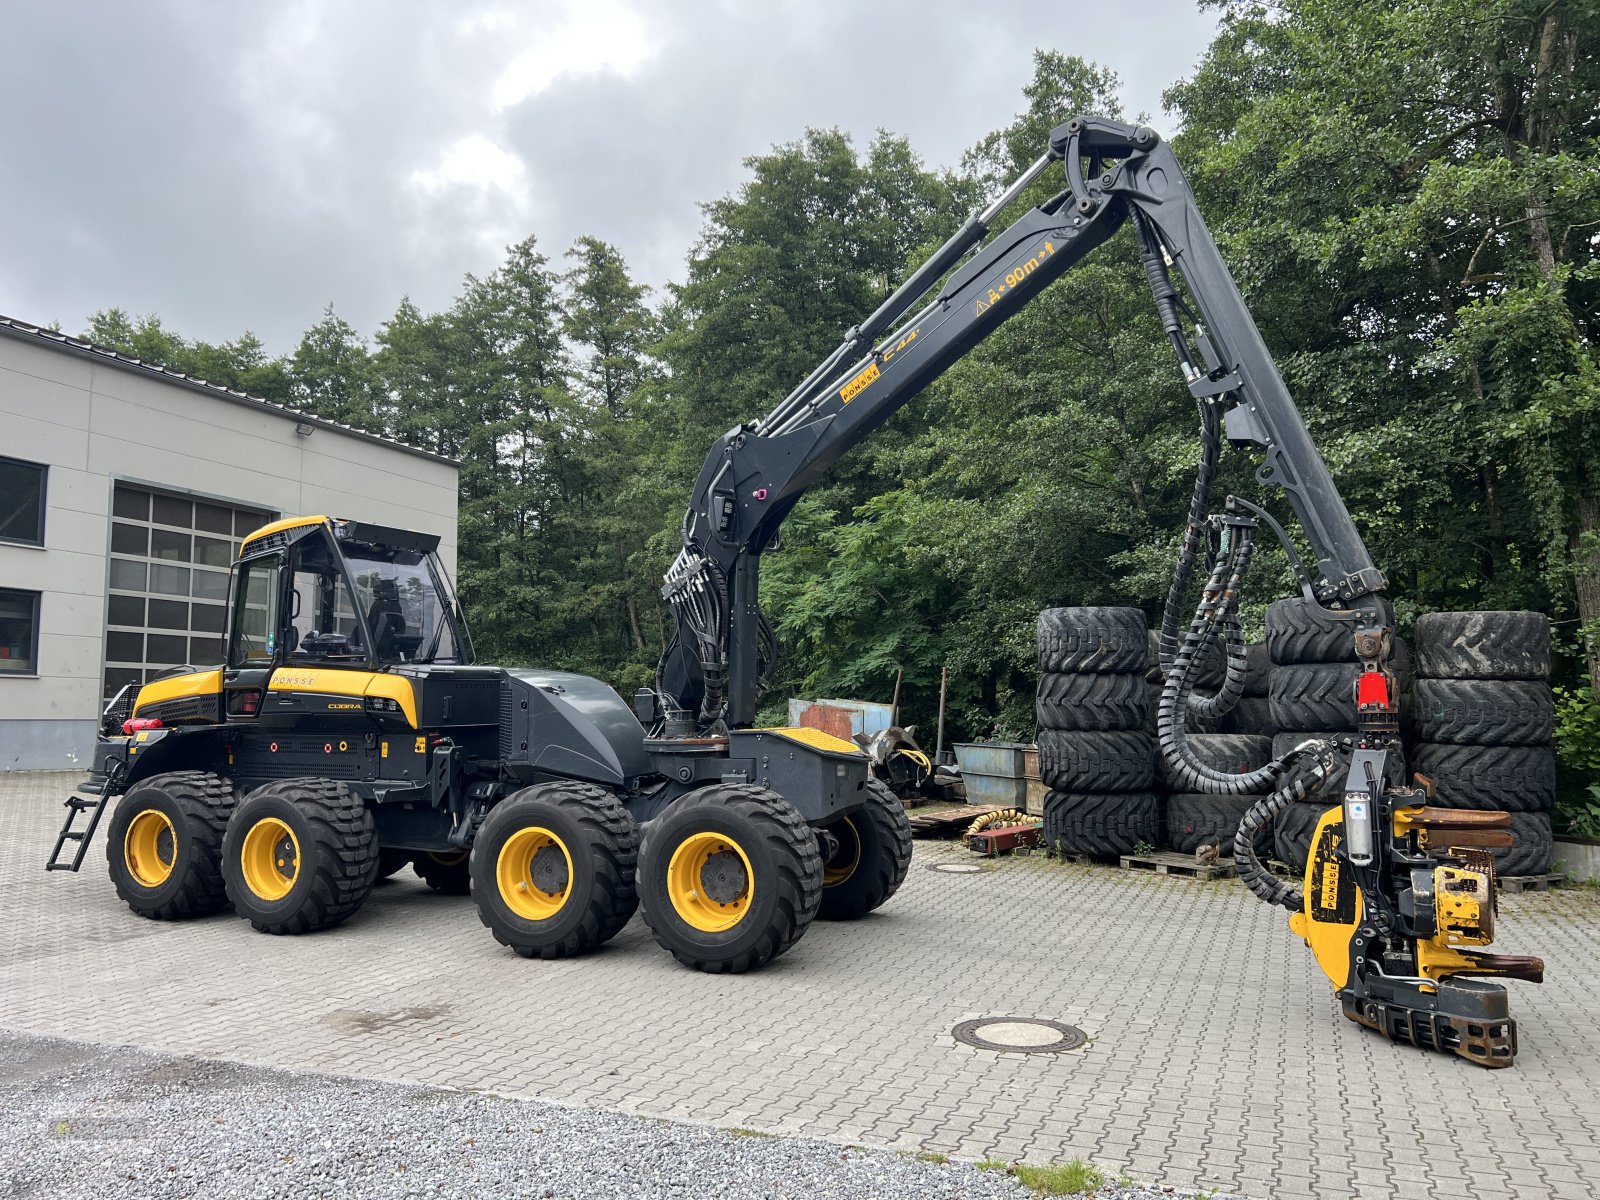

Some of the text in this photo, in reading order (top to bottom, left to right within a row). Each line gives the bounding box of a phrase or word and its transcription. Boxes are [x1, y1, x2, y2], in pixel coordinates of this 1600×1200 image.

[842, 367, 879, 402] PONSSE
[272, 677, 315, 686] PONSSE
[1326, 864, 1337, 909] PONSSE
